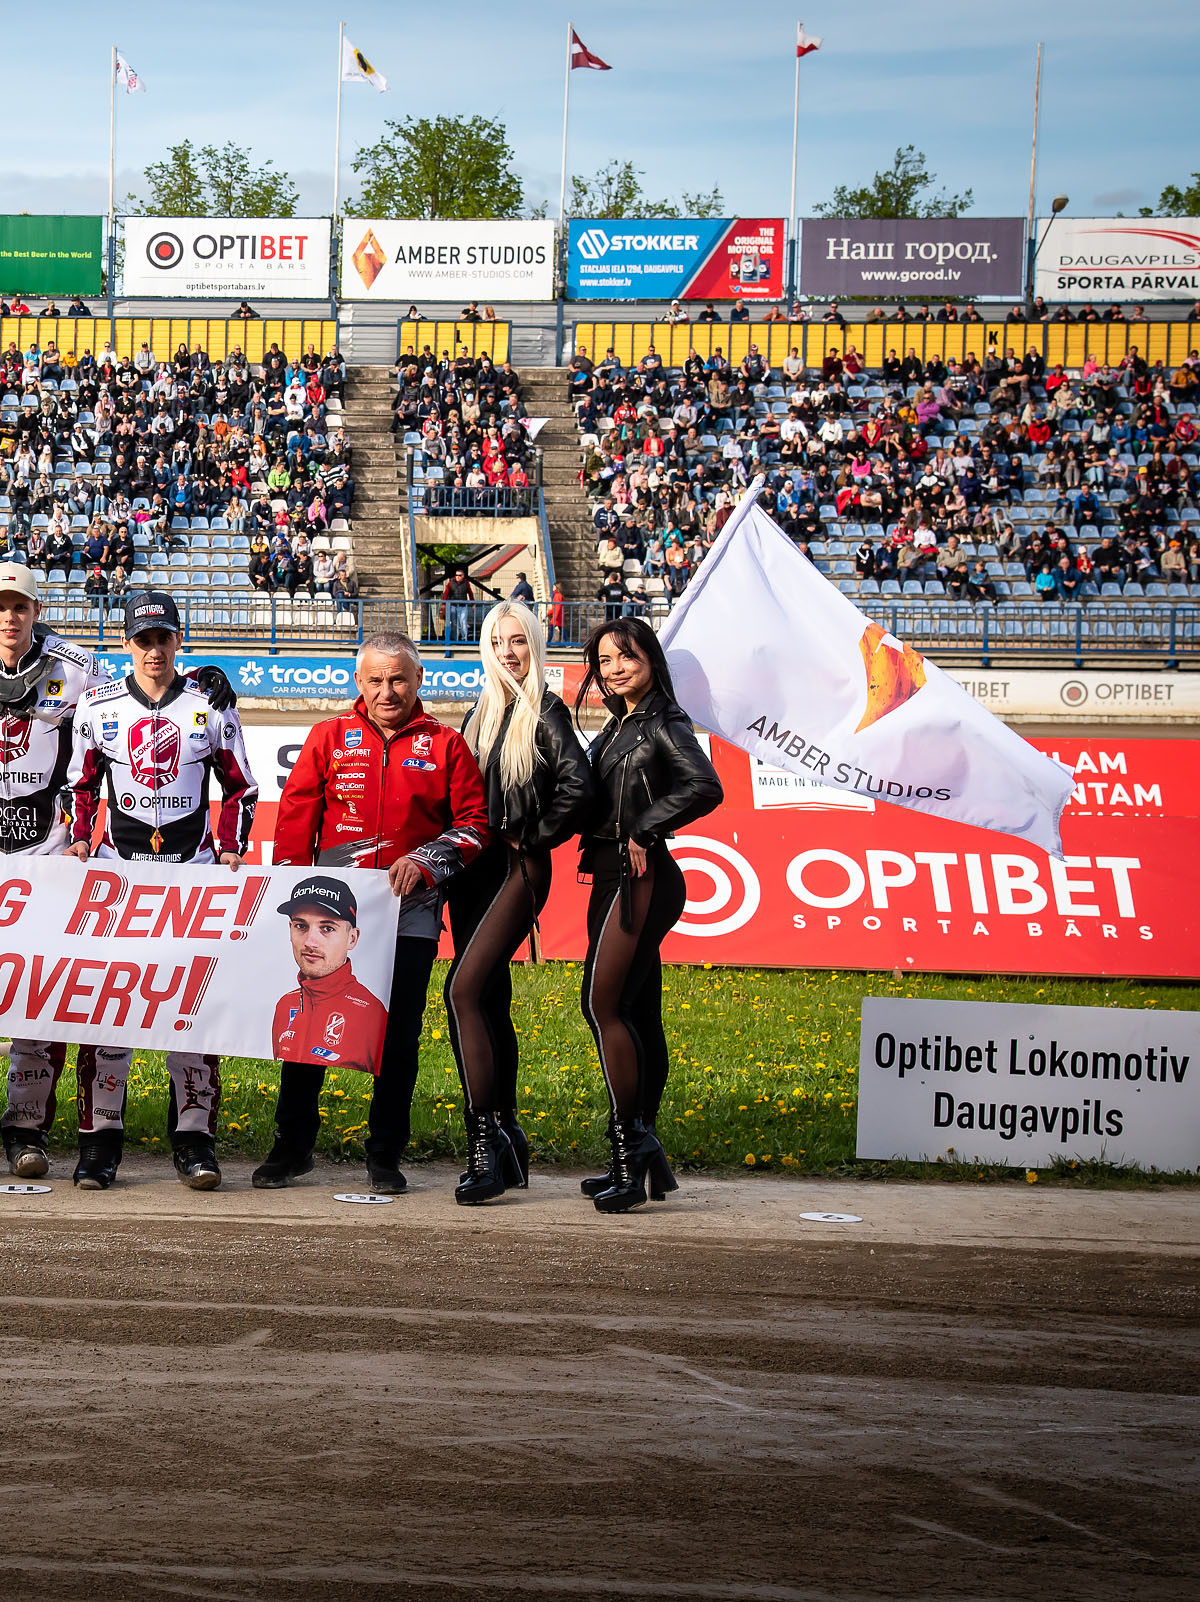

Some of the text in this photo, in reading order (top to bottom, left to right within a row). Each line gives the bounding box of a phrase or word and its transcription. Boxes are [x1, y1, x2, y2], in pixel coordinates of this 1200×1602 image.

[759, 227, 775, 236] THE
[192, 234, 308, 260] OPTIBET
[610, 235, 698, 251] STOKKER
[734, 237, 774, 246] ORIGINAL
[71, 251, 92, 259] World
[395, 245, 546, 265] AMBER STUDIOS
[727, 245, 774, 254] MOTOR OIL
[826, 238, 998, 266] Наш город.
[194, 262, 255, 271] SPORTA
[1060, 254, 1196, 266] DAUGAVPILS
[408, 269, 534, 279] WWW.AMBER-STUDIOS.COM
[579, 264, 684, 274] STACIJAS IELA DAUGAVPILS
[860, 268, 962, 283] www.gorod.lv
[185, 282, 266, 292] optibetsportabars.lv
[579, 277, 632, 287] www.stokker.lv
[1057, 276, 1125, 290] SPORTA
[988, 331, 999, 345] K
[46, 637, 90, 665] Interio
[268, 664, 349, 685] trodo
[272, 686, 348, 695] CAR PARTS ONLINE
[420, 688, 465, 698] CAR PARTS
[1095, 683, 1175, 701] OPTIBET
[133, 725, 173, 759] LOKOMOTIV
[746, 714, 952, 801] AMBER STUDIOS
[335, 782, 365, 790] SemiCom
[758, 776, 789, 787] MADE
[794, 777, 806, 787] IN
[139, 796, 193, 809] OPTIBET
[131, 852, 154, 863] AMBER
[785, 848, 1141, 918] OPTIBET
[293, 884, 341, 902] dankemi
[64, 868, 272, 942] RENE!
[793, 913, 1154, 940] SPORTA BĀRS
[875, 1032, 1190, 1084] Optibet Lokomotiv
[933, 1090, 1124, 1143] Daugavpils
